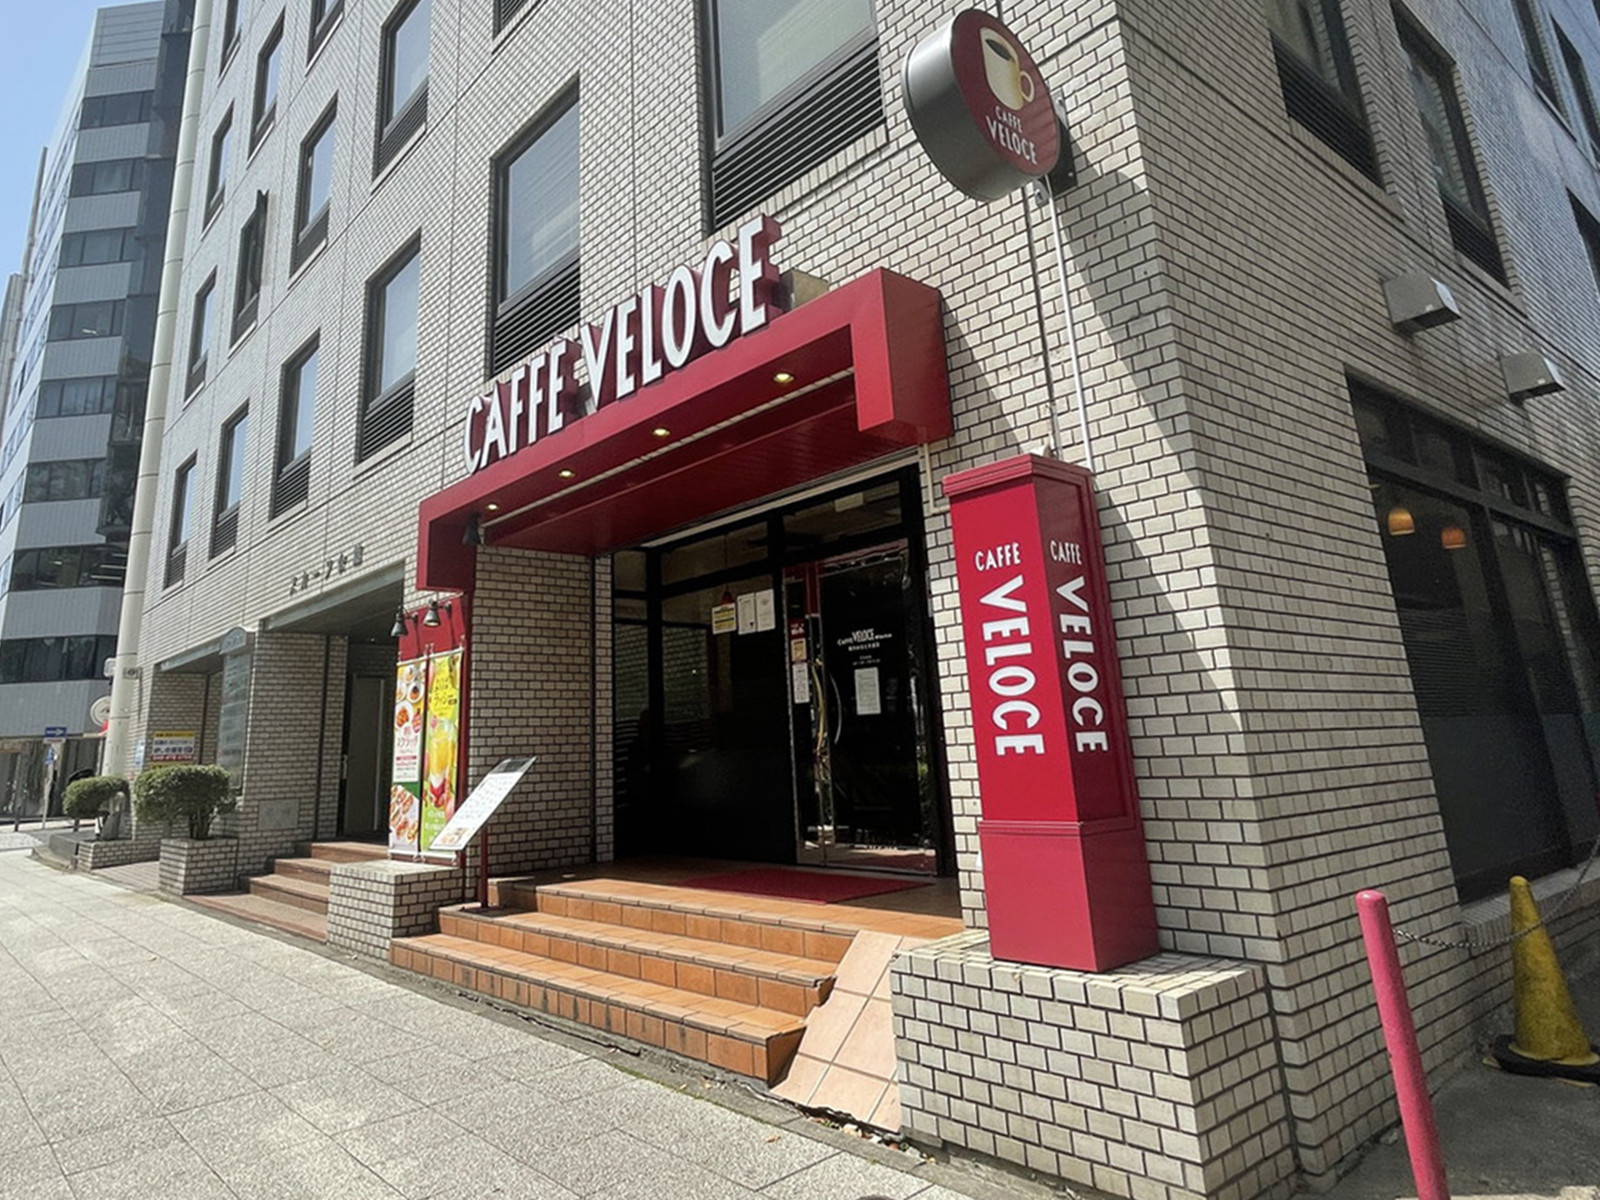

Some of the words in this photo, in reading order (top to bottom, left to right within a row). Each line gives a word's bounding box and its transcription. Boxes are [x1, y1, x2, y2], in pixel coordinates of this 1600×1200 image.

[985, 115, 1037, 164] VELOCE
[995, 106, 1023, 133] CAFFE
[463, 340, 567, 474] CAFFE
[580, 213, 767, 414] VELOCE
[974, 541, 1021, 571] CAFFE
[1050, 540, 1082, 565] CAFFE
[979, 574, 1045, 756] VELOCE
[1056, 575, 1109, 753] VELOCE
